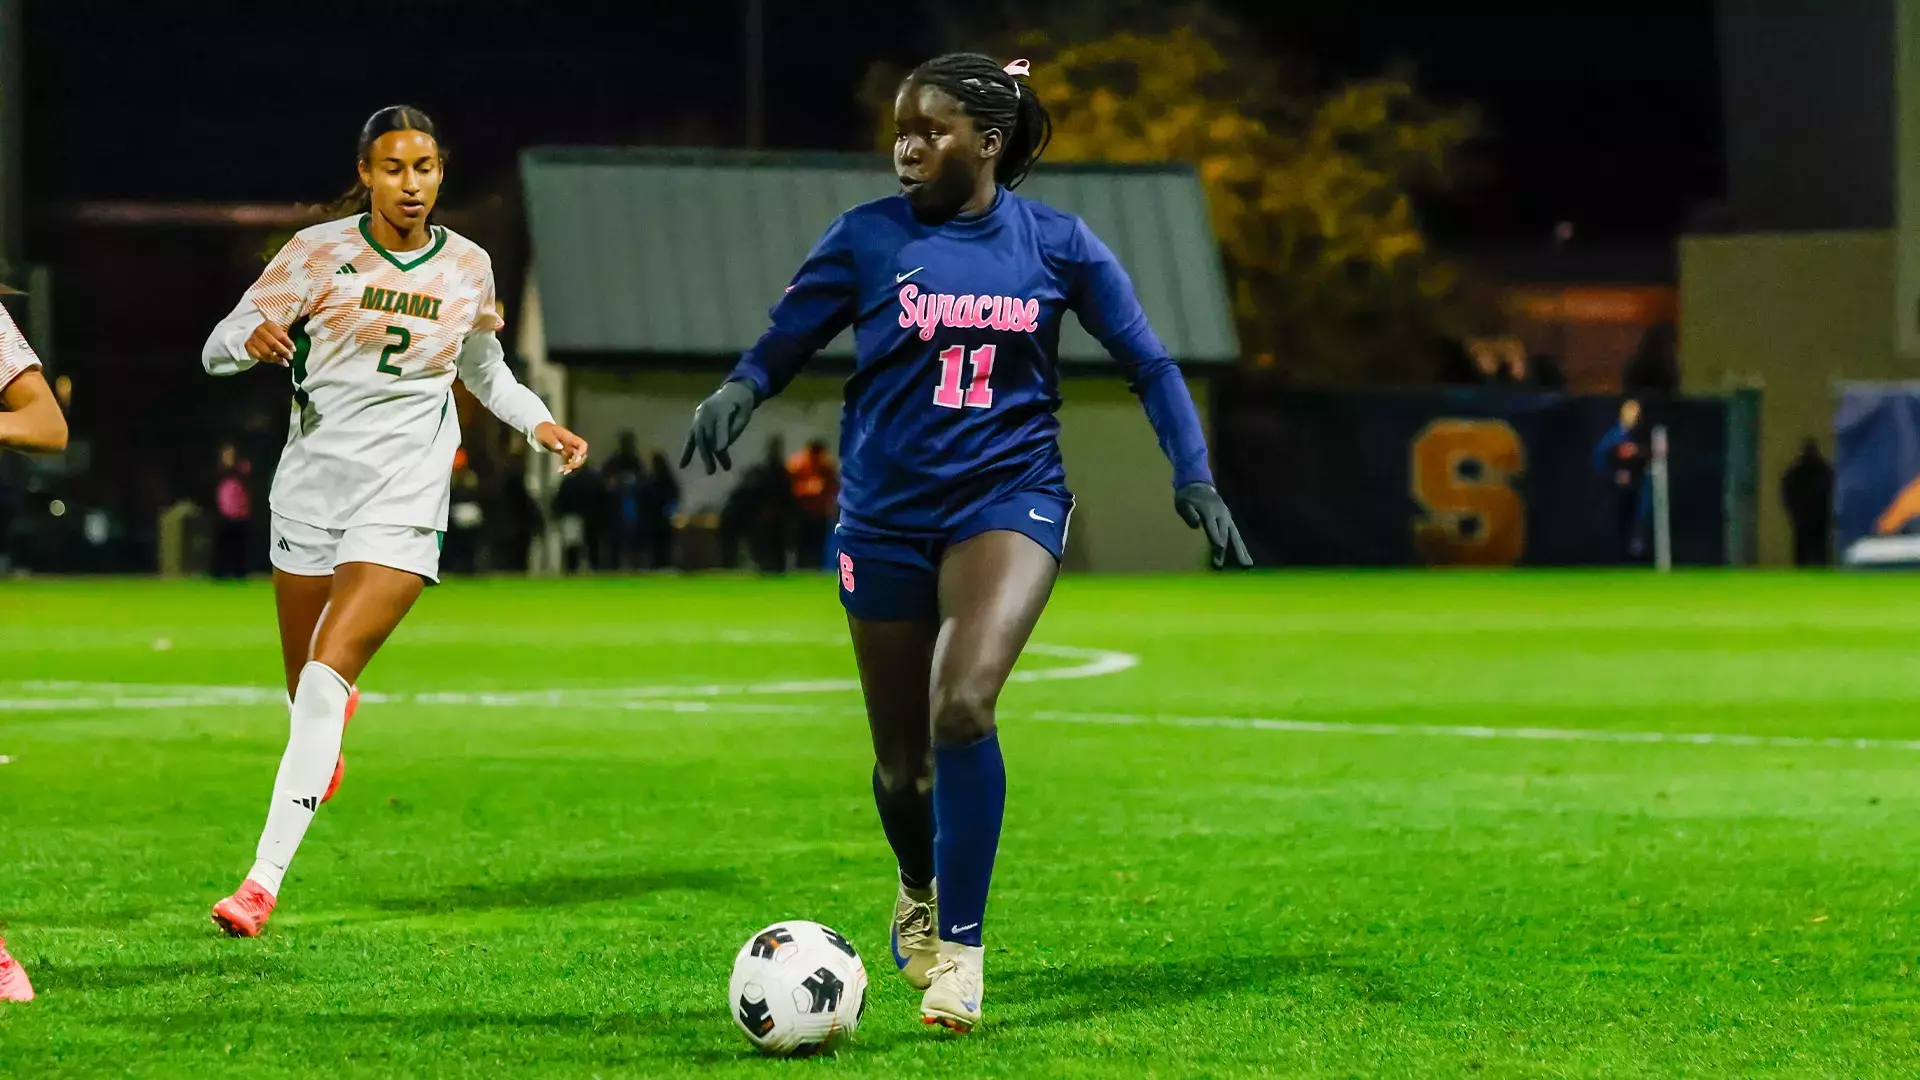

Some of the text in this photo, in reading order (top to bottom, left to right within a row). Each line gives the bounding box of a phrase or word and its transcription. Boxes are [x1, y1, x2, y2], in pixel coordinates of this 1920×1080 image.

[359, 285, 443, 320] MIAMI
[899, 284, 1040, 341] Syracuse
[376, 325, 411, 377] 2
[933, 344, 997, 409] 11
[1411, 417, 1524, 570] S
